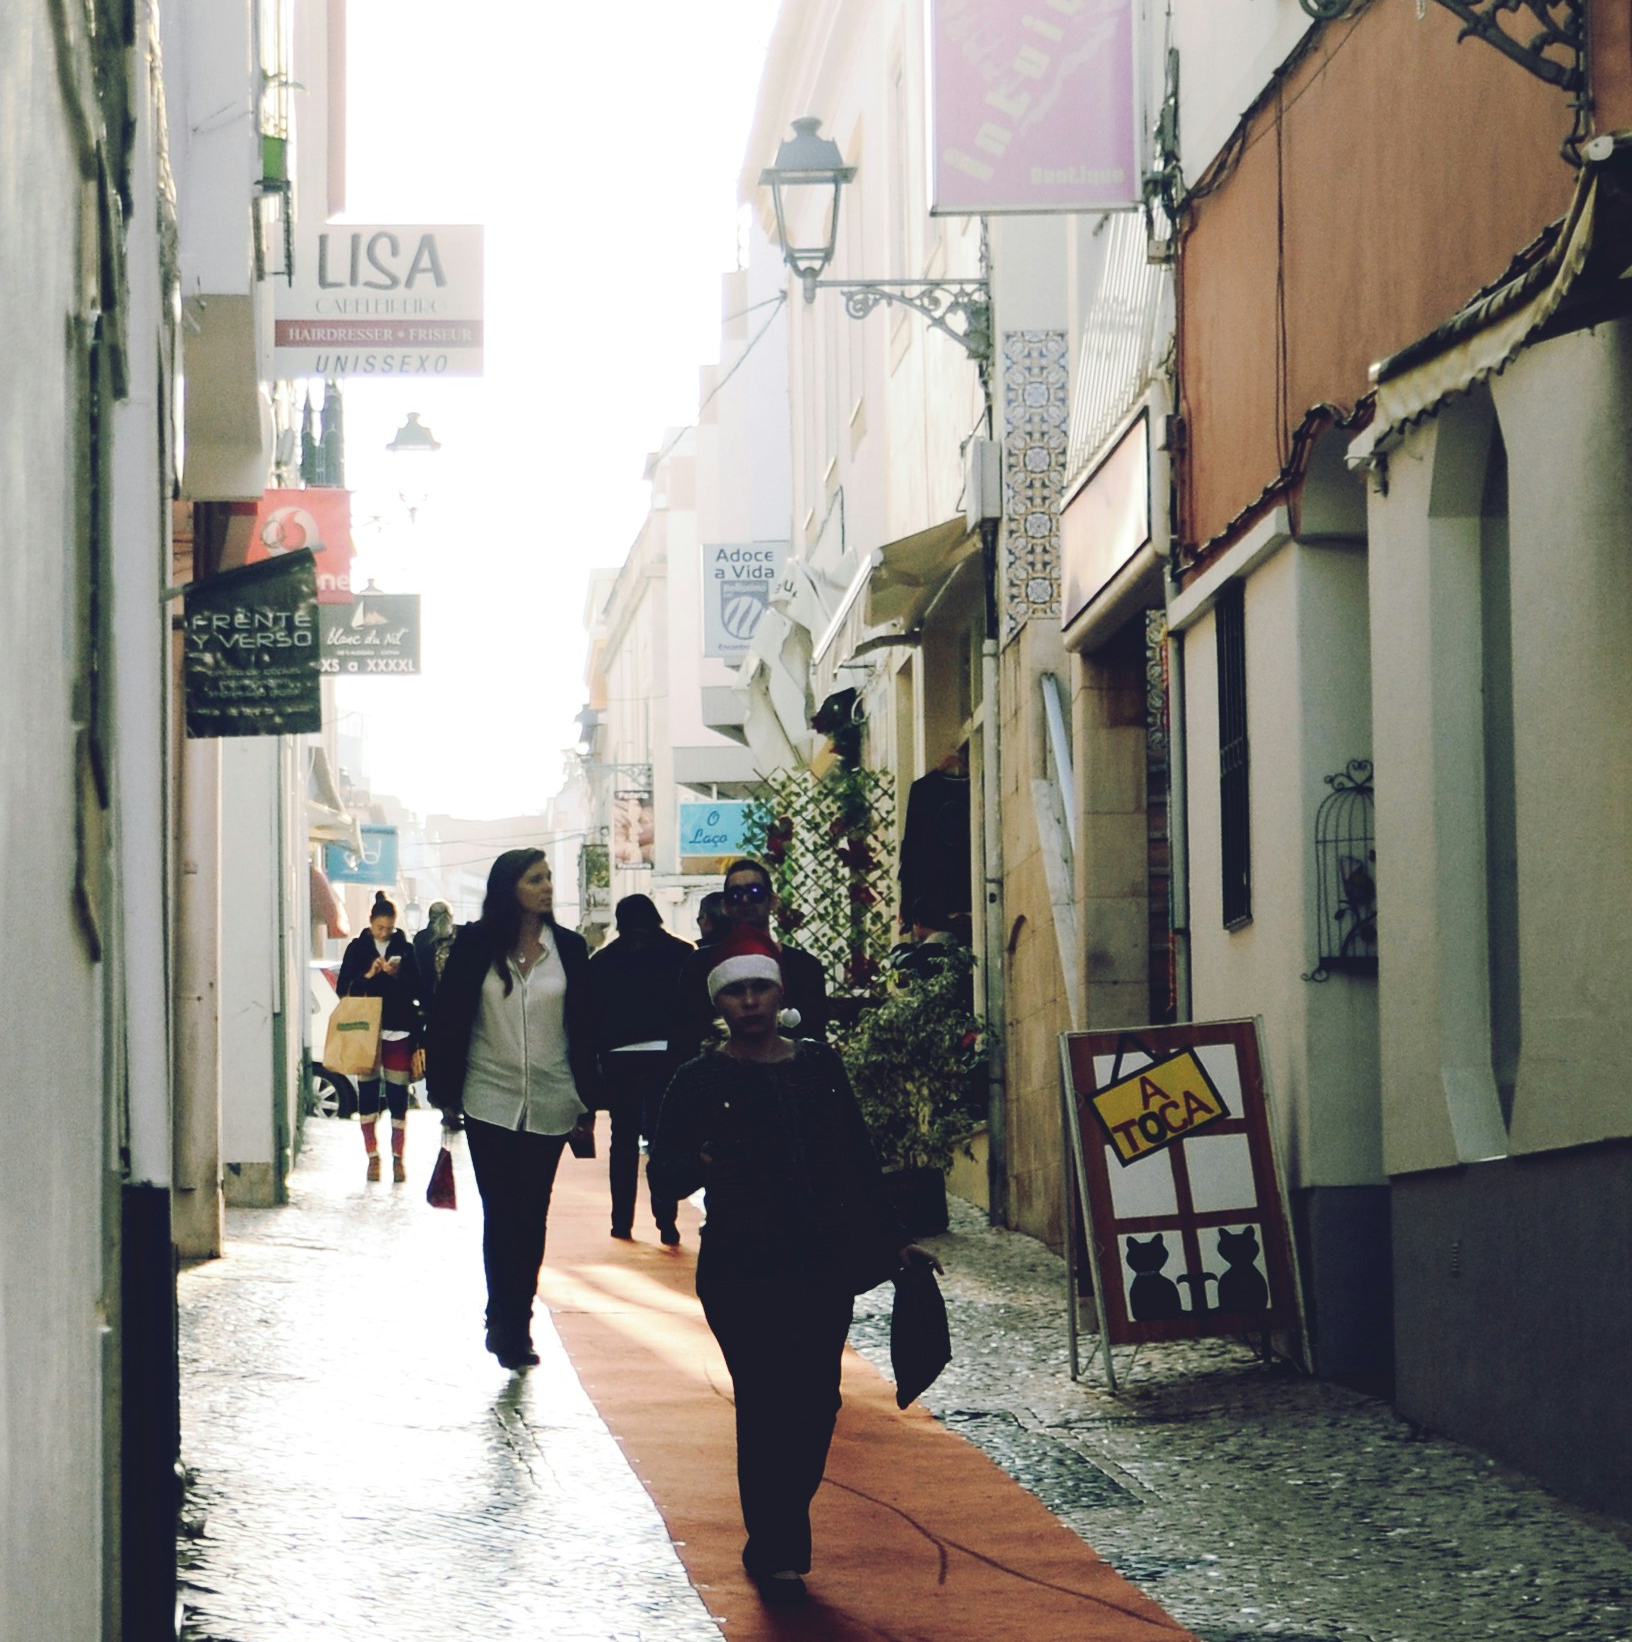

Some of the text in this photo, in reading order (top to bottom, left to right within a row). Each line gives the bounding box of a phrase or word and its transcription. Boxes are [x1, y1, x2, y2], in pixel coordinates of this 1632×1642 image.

[317, 231, 449, 291] LISA
[315, 298, 448, 314] CABELEIREIRO
[288, 327, 473, 342] HAIRDRESSER FRISEUR
[315, 354, 449, 374] UNISSEXO
[716, 548, 774, 563] Adoce
[714, 564, 775, 579] a Vida
[192, 611, 312, 630] FRENTE
[191, 630, 313, 650] Y VERSO
[326, 626, 362, 645] blanc
[364, 628, 381, 645] du
[320, 658, 415, 672] XS a XXXXL
[707, 810, 720, 827] O
[689, 828, 728, 847] Laço
[1139, 1075, 1171, 1112] A
[1111, 1089, 1215, 1154] TOCA
